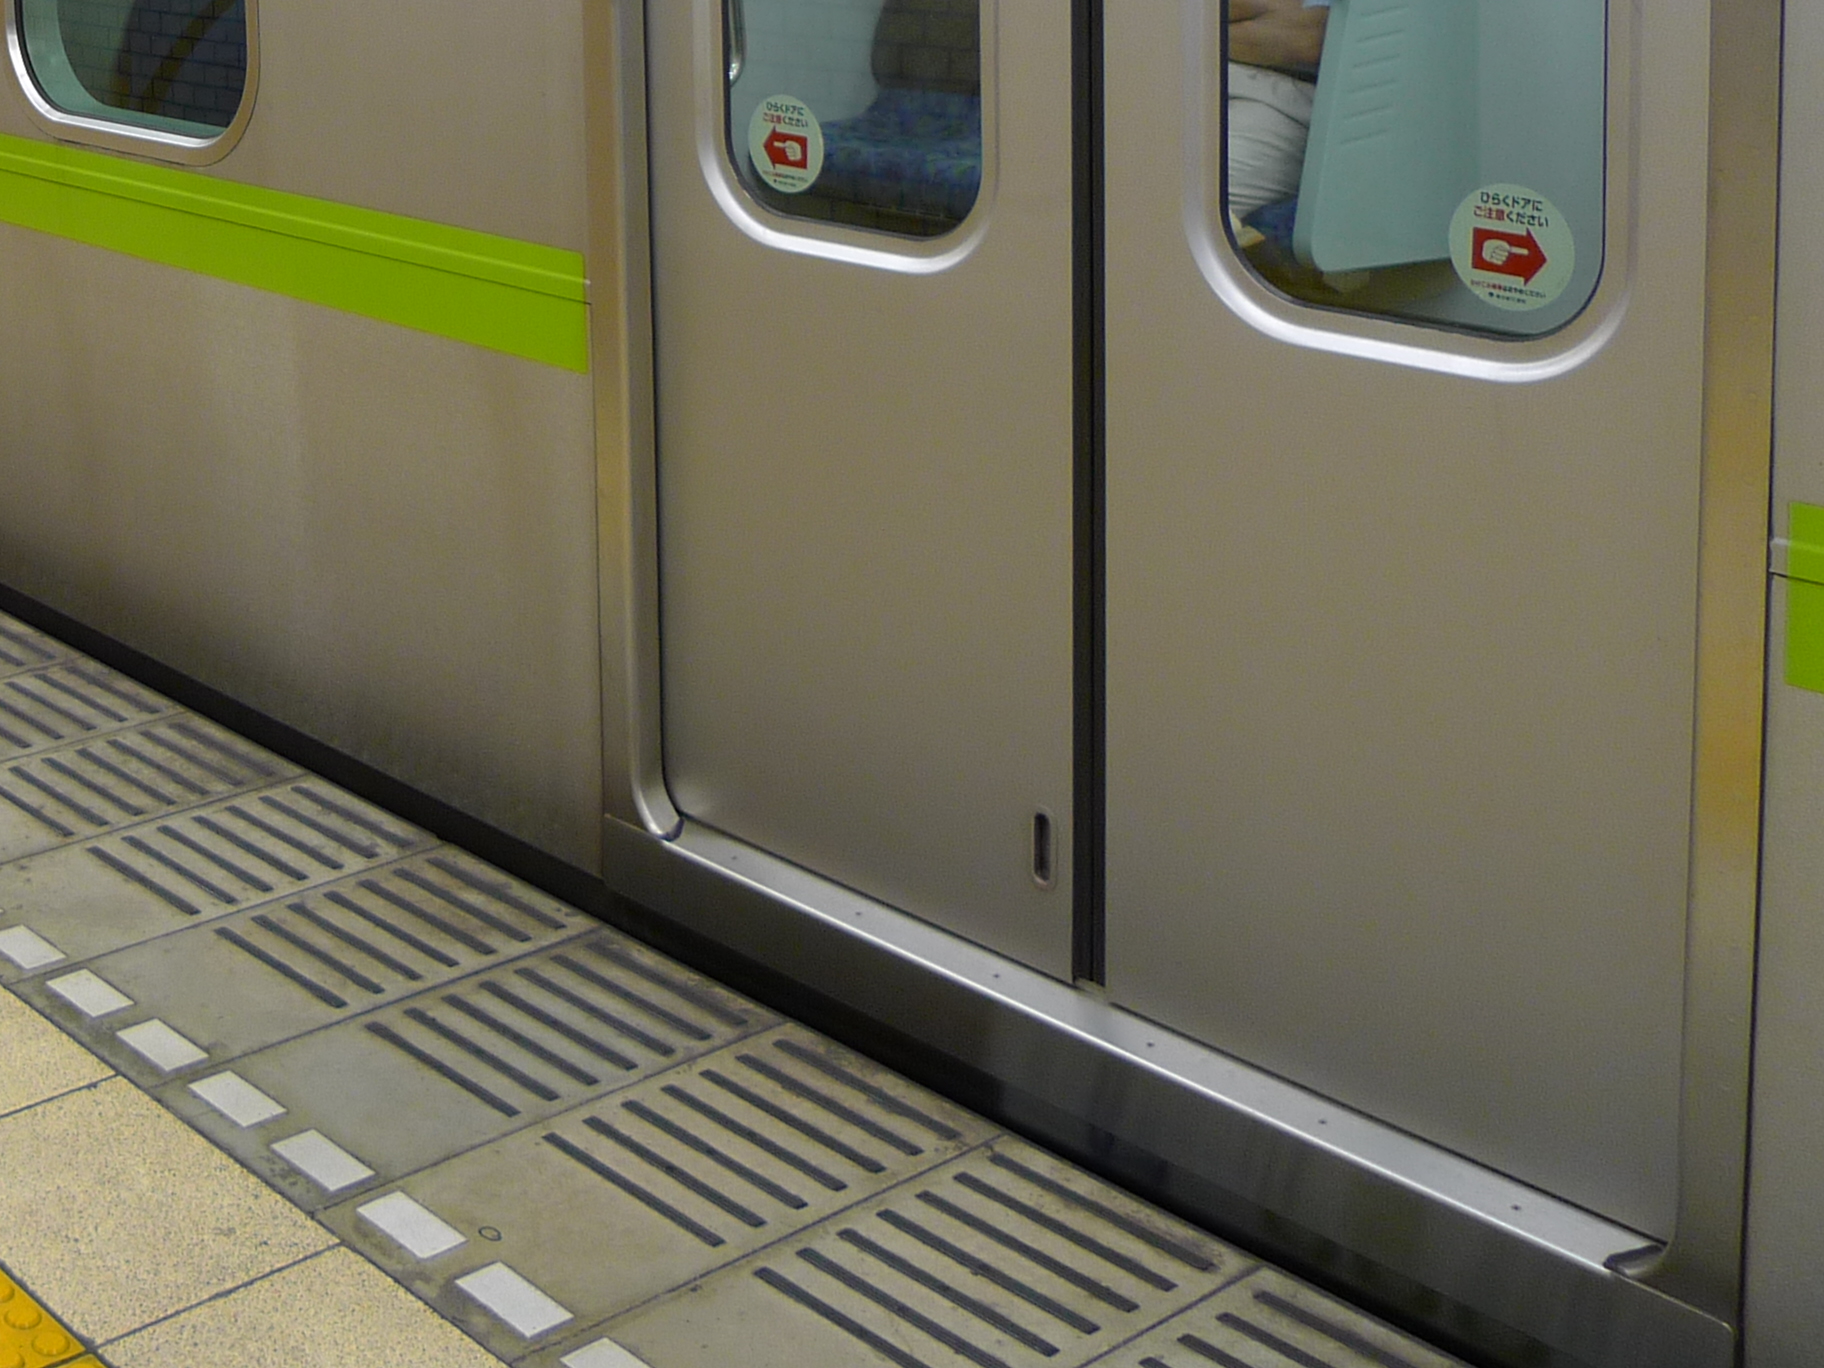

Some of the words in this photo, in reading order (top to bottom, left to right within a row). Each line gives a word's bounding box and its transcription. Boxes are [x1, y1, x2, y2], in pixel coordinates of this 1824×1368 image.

[765, 101, 805, 116] ひらくドアに
[1480, 191, 1544, 212] ひらくドアに
[1473, 205, 1549, 228] ご注意ください
